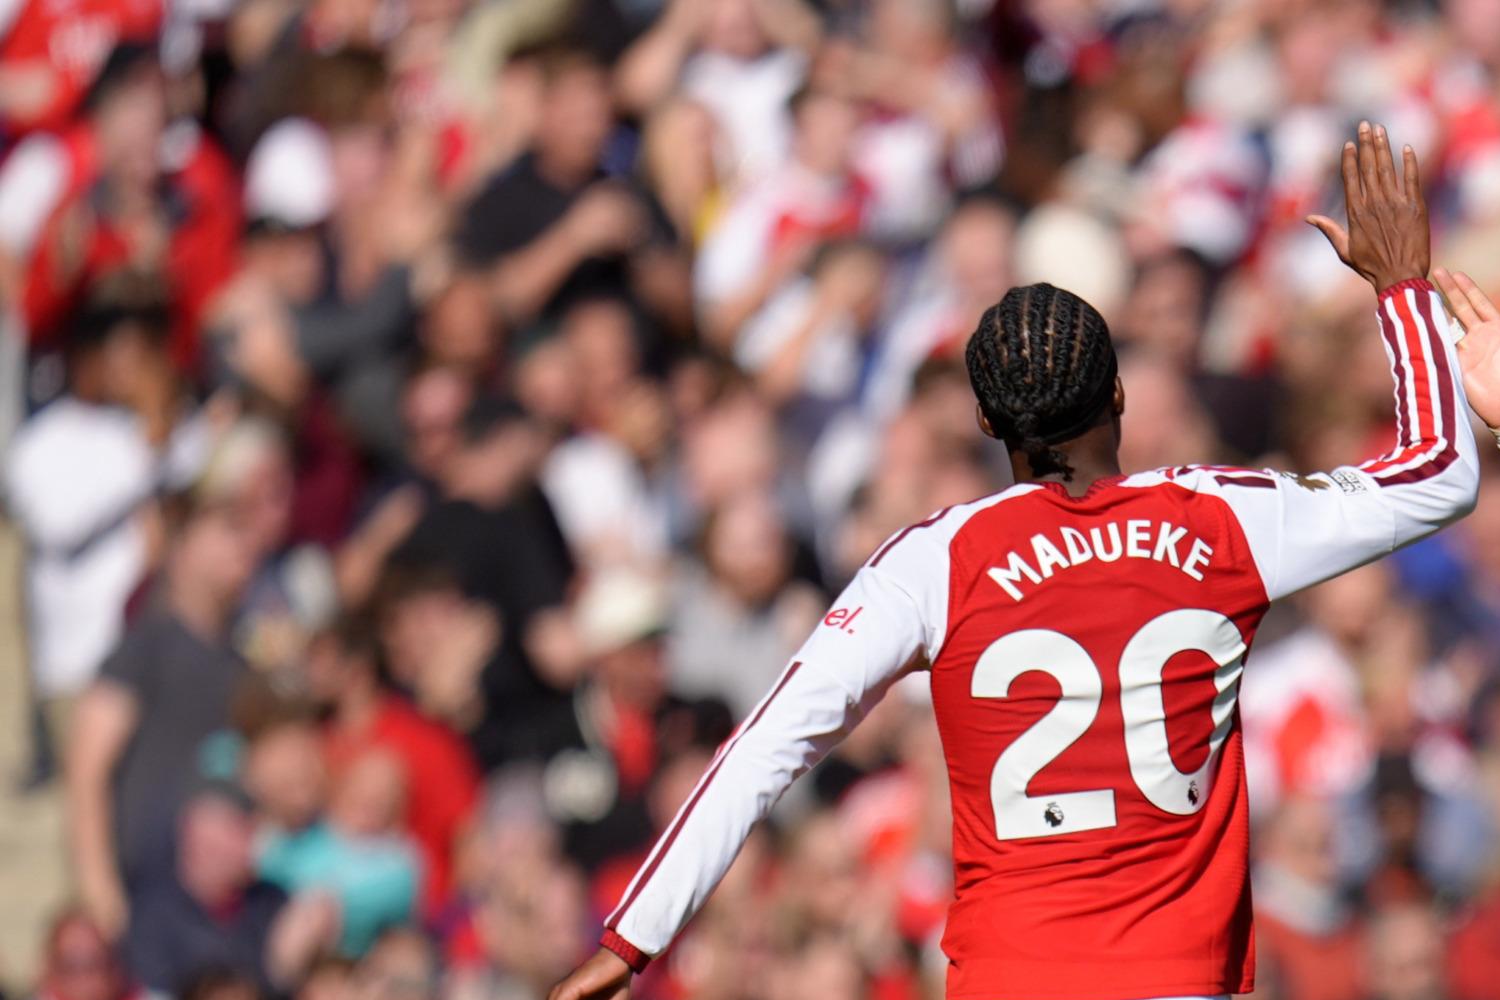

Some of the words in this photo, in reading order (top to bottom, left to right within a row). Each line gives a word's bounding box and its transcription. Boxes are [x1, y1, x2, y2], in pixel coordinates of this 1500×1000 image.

[986, 519, 1214, 602] MADUEKE
[823, 606, 864, 635] el.
[970, 608, 1247, 841] 20
